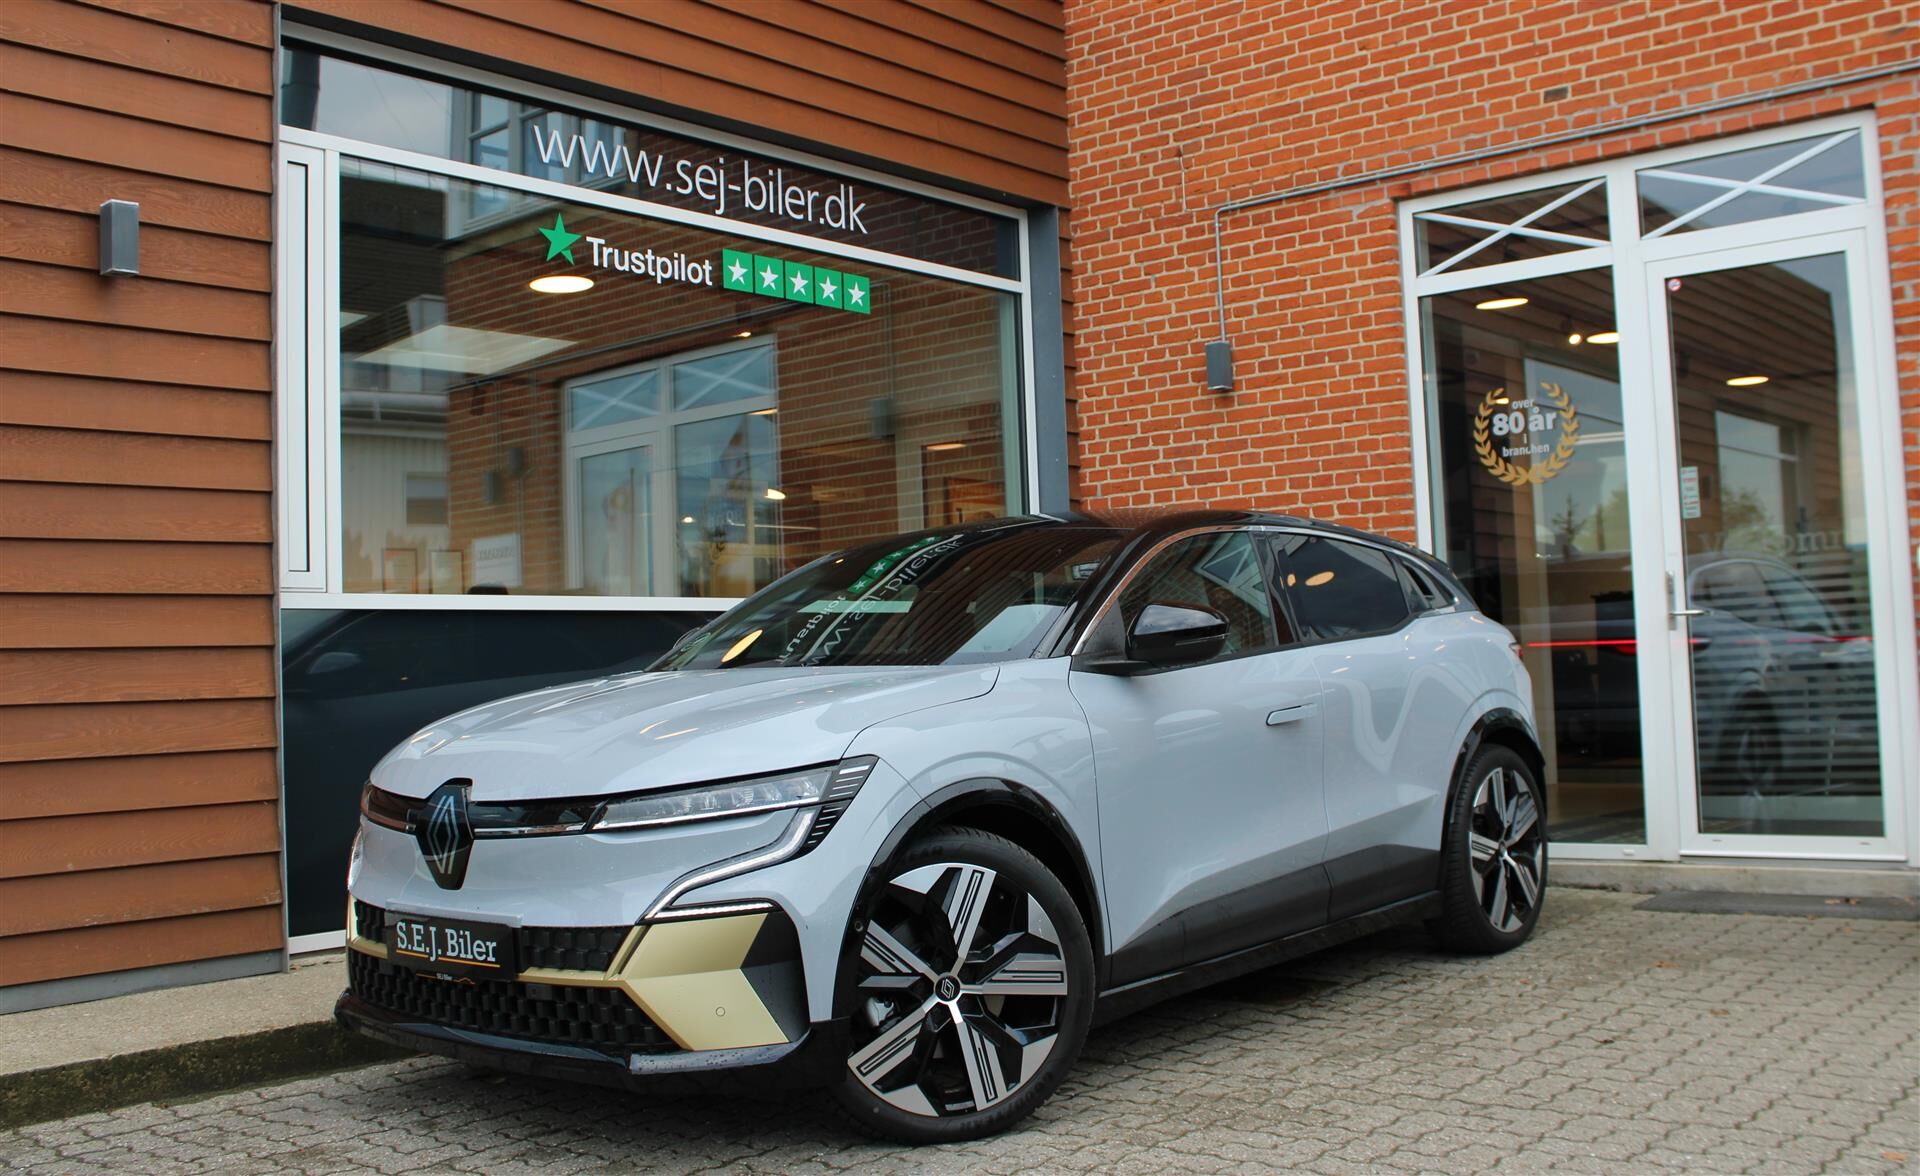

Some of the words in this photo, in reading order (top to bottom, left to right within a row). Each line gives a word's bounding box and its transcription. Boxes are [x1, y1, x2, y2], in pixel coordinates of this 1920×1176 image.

[533, 124, 868, 234] www.sej-biler.dk
[585, 235, 713, 287] Trustpilot
[1492, 411, 1525, 436] 80
[1528, 406, 1557, 432] år
[1512, 398, 1535, 410] over
[1502, 443, 1550, 458] branchen
[396, 921, 442, 962] S.E.J.
[445, 928, 497, 962] Biler
